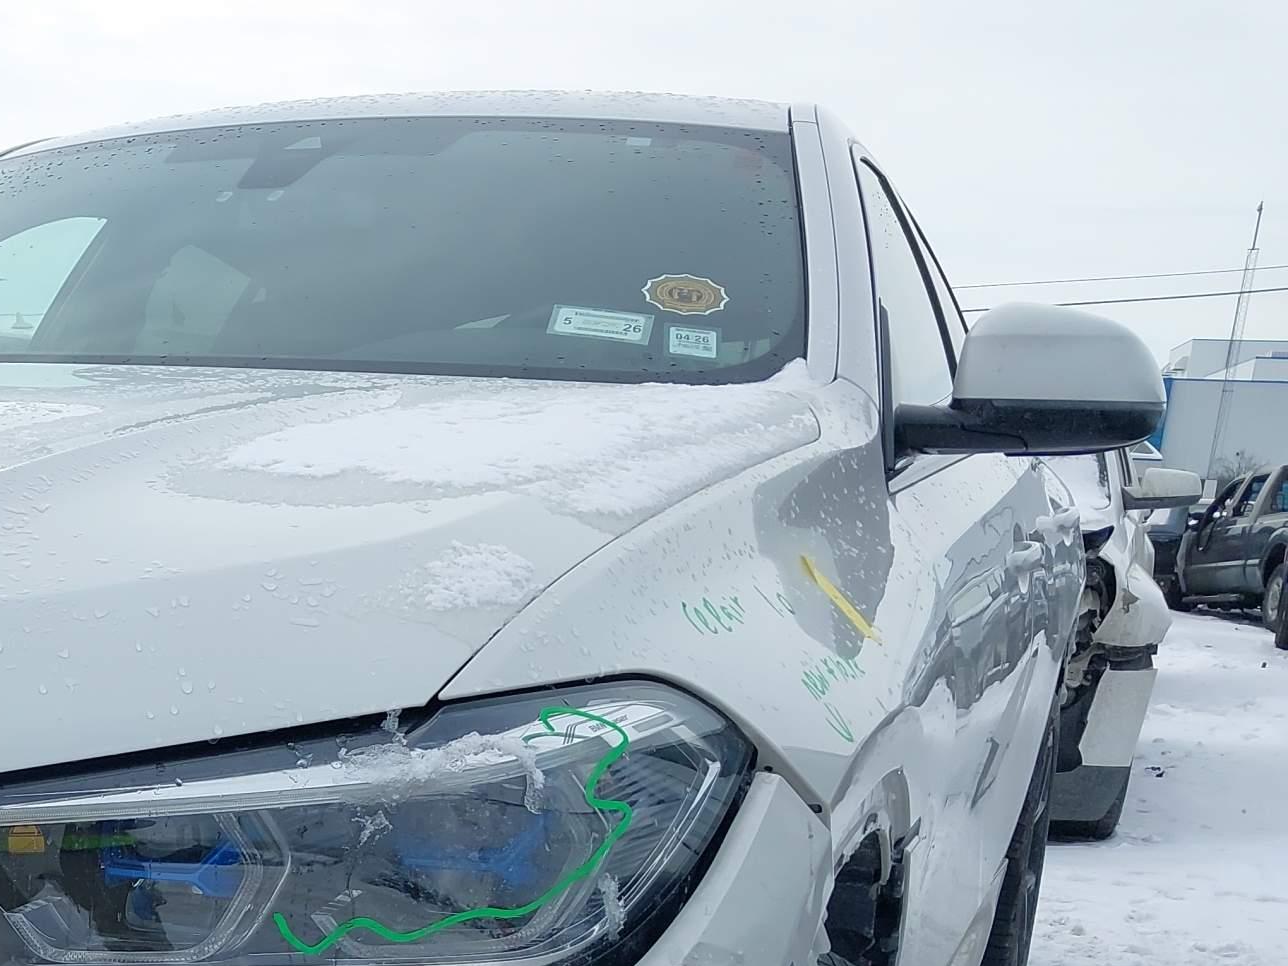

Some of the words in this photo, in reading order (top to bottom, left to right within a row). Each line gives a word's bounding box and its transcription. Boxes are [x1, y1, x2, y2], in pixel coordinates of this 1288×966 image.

[562, 316, 573, 326] 5
[623, 323, 642, 334] 26
[675, 333, 690, 341] 04
[694, 335, 710, 343] 26
